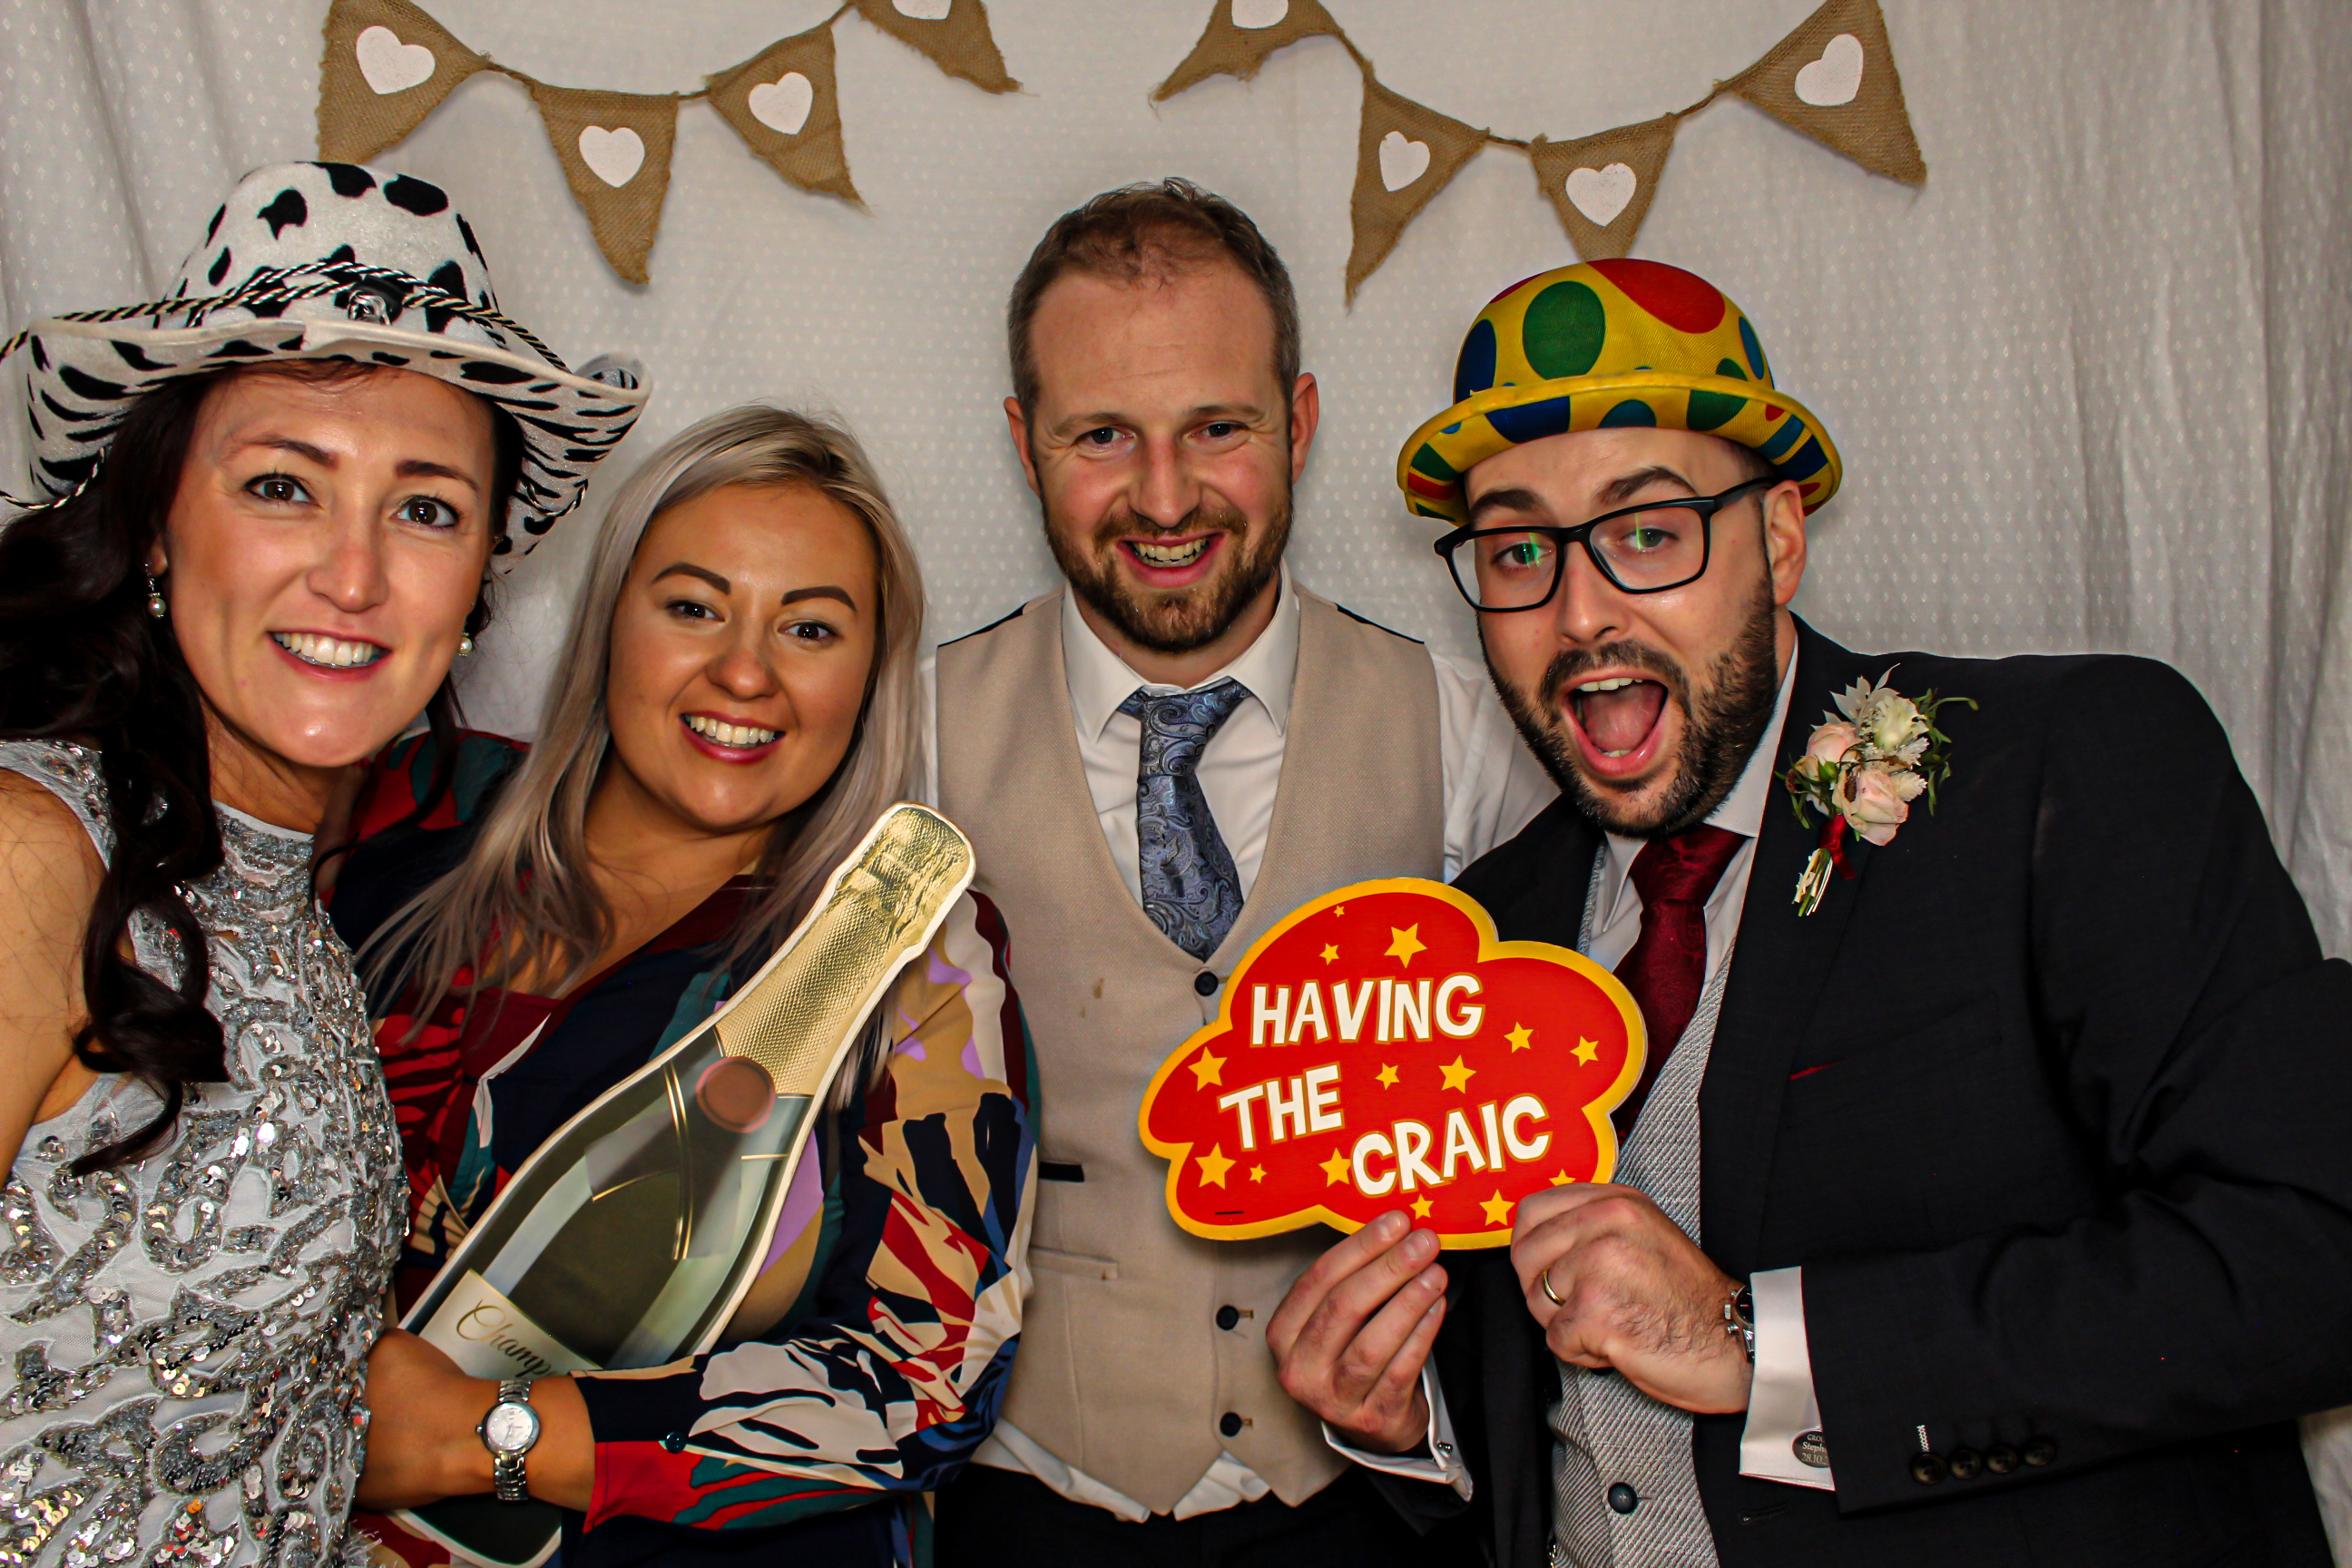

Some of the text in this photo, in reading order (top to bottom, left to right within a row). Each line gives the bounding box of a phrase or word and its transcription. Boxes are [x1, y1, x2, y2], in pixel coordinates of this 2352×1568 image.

[1250, 974, 1484, 1046] HAVING
[1219, 1063, 1343, 1150] THE
[1352, 1095, 1550, 1196] CRAIC
[456, 1299, 555, 1377] Champ
[1802, 1441, 1826, 1454] Steph
